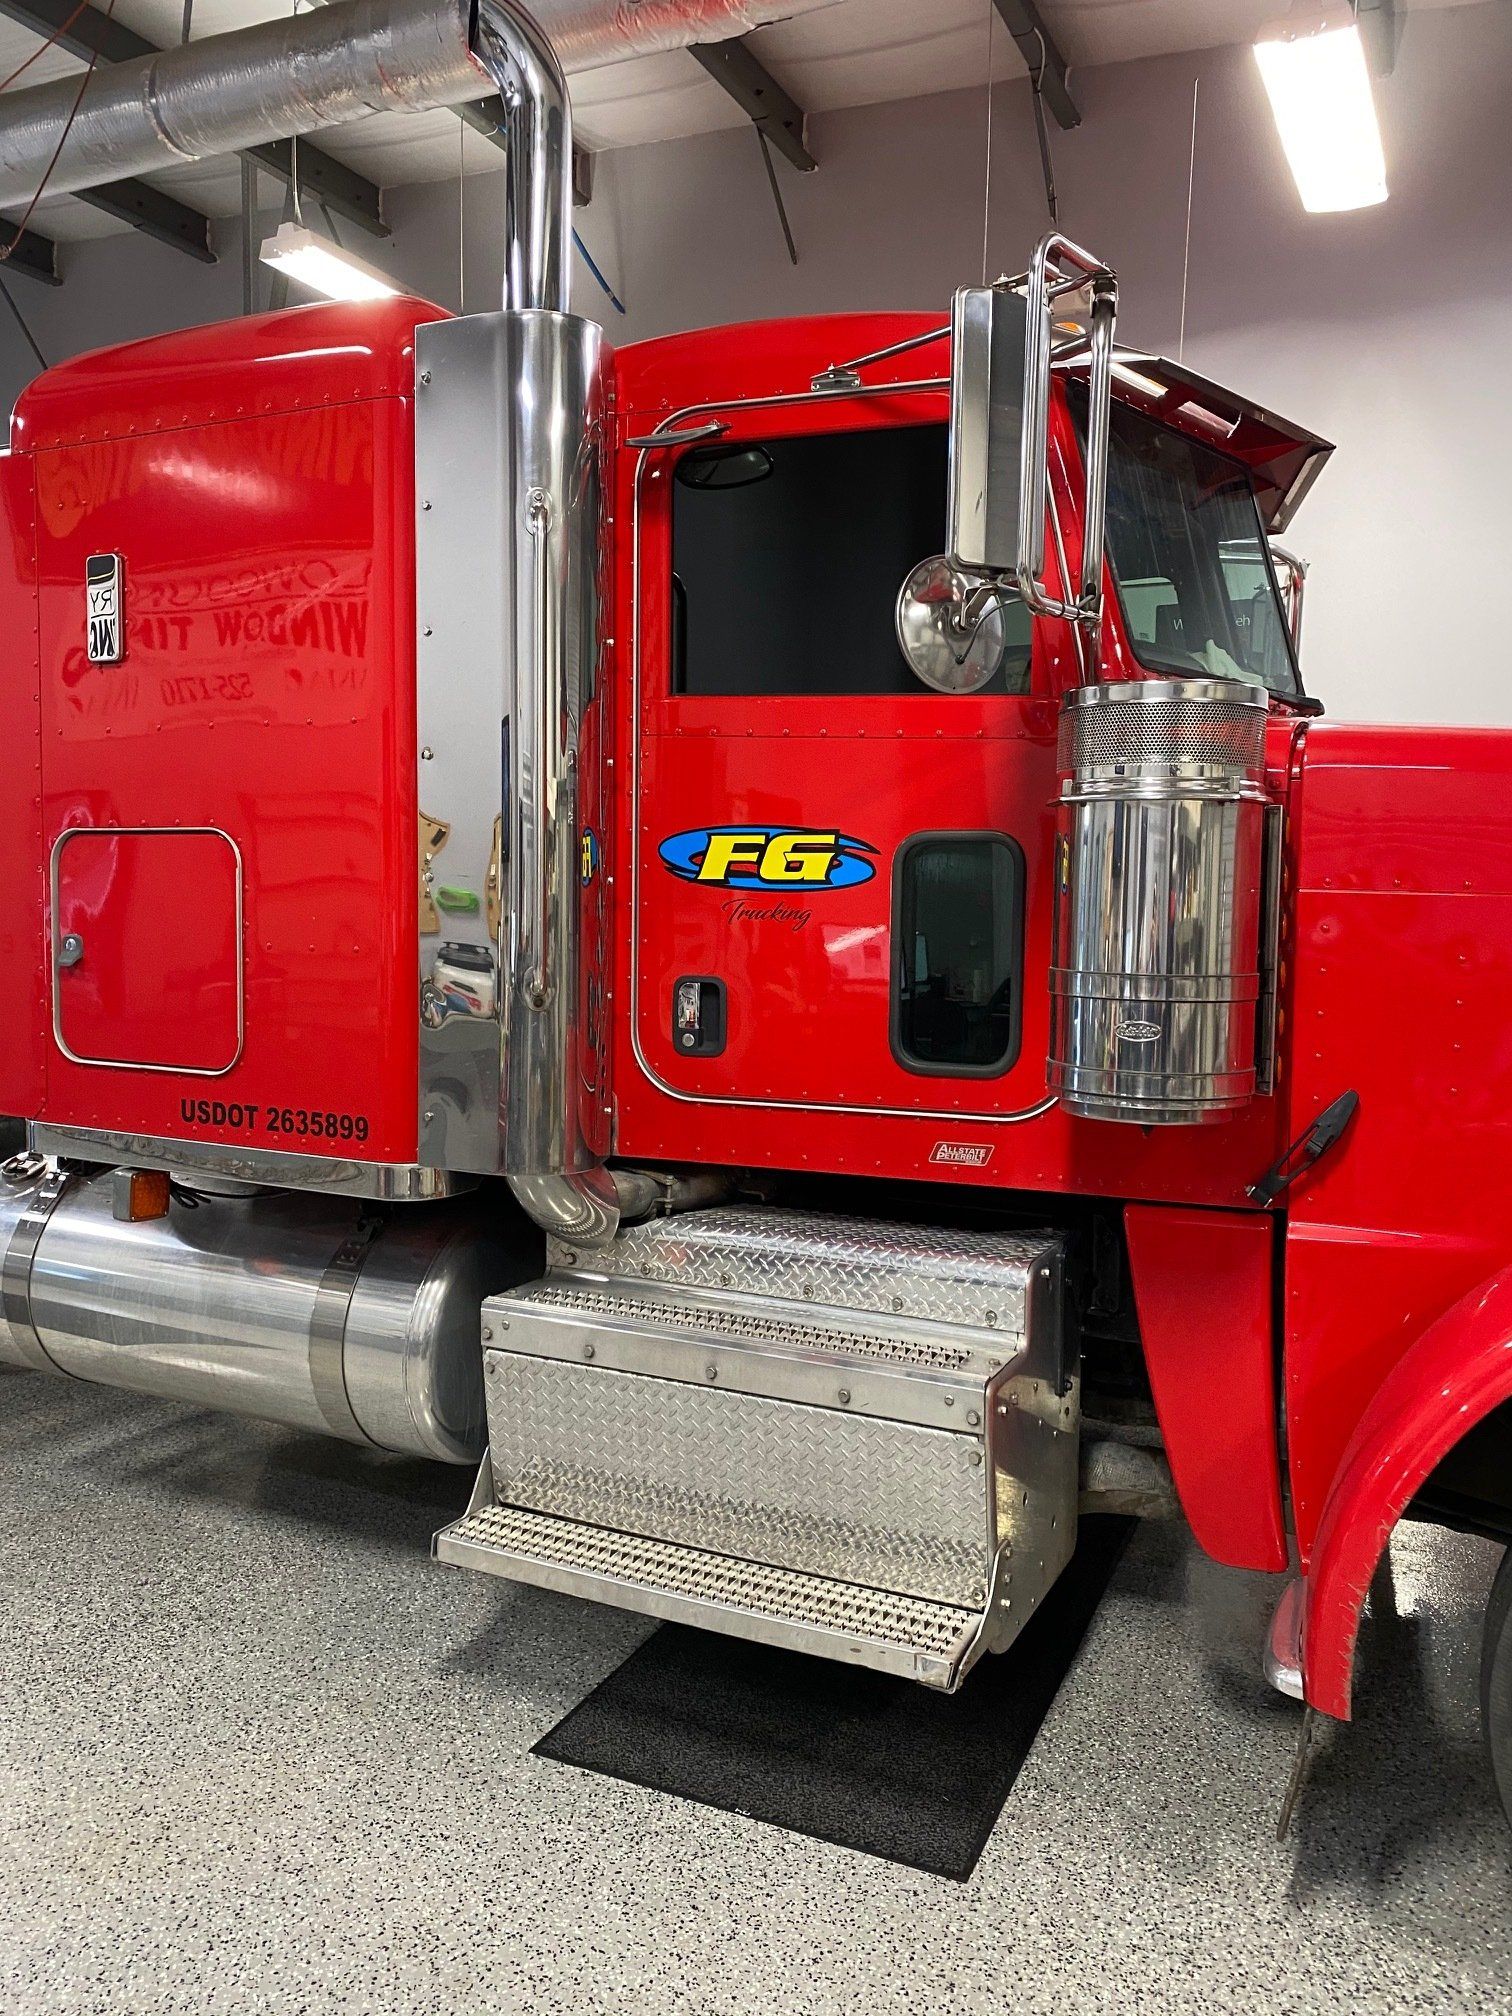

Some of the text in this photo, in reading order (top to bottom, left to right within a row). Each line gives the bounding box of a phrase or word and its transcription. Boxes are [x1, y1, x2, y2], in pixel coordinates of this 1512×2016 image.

[696, 833, 838, 882] FG
[721, 898, 813, 931] Trucking
[180, 1098, 369, 1141] USDOT 2635899
[939, 1144, 987, 1155] ALLSTATE
